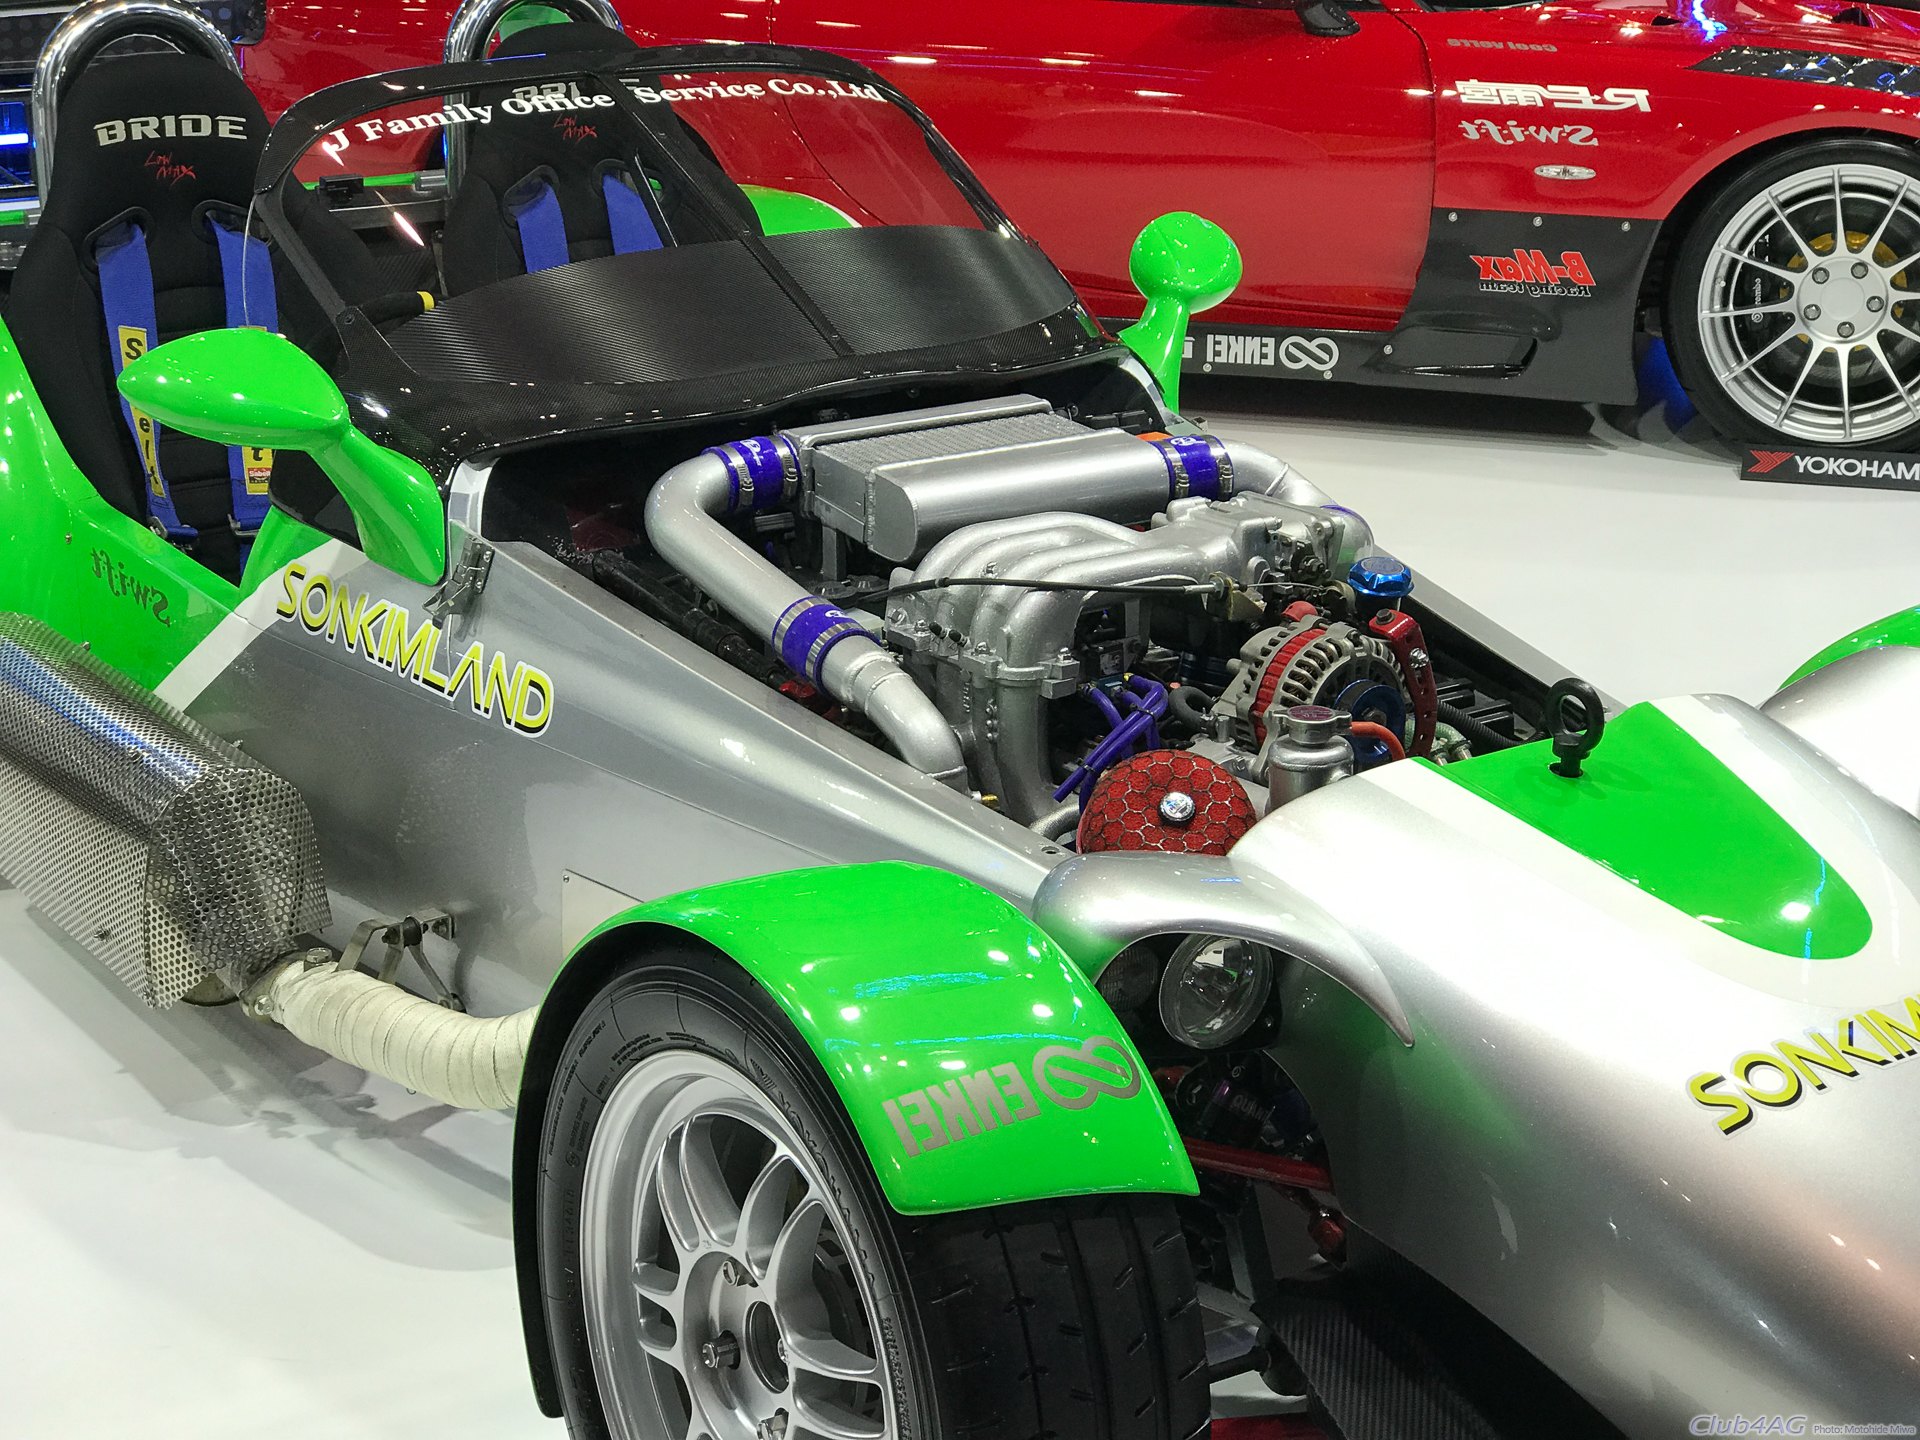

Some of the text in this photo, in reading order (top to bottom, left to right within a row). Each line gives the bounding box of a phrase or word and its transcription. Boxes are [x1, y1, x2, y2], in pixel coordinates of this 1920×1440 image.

[355, 102, 493, 143] Family
[501, 93, 616, 115] Office
[634, 78, 766, 103] Service
[93, 114, 248, 146] BRIDE
[1752, 277, 1762, 305] rembo
[1795, 455, 1920, 481] YOKOHAM
[276, 562, 553, 736] SONKIMLAND
